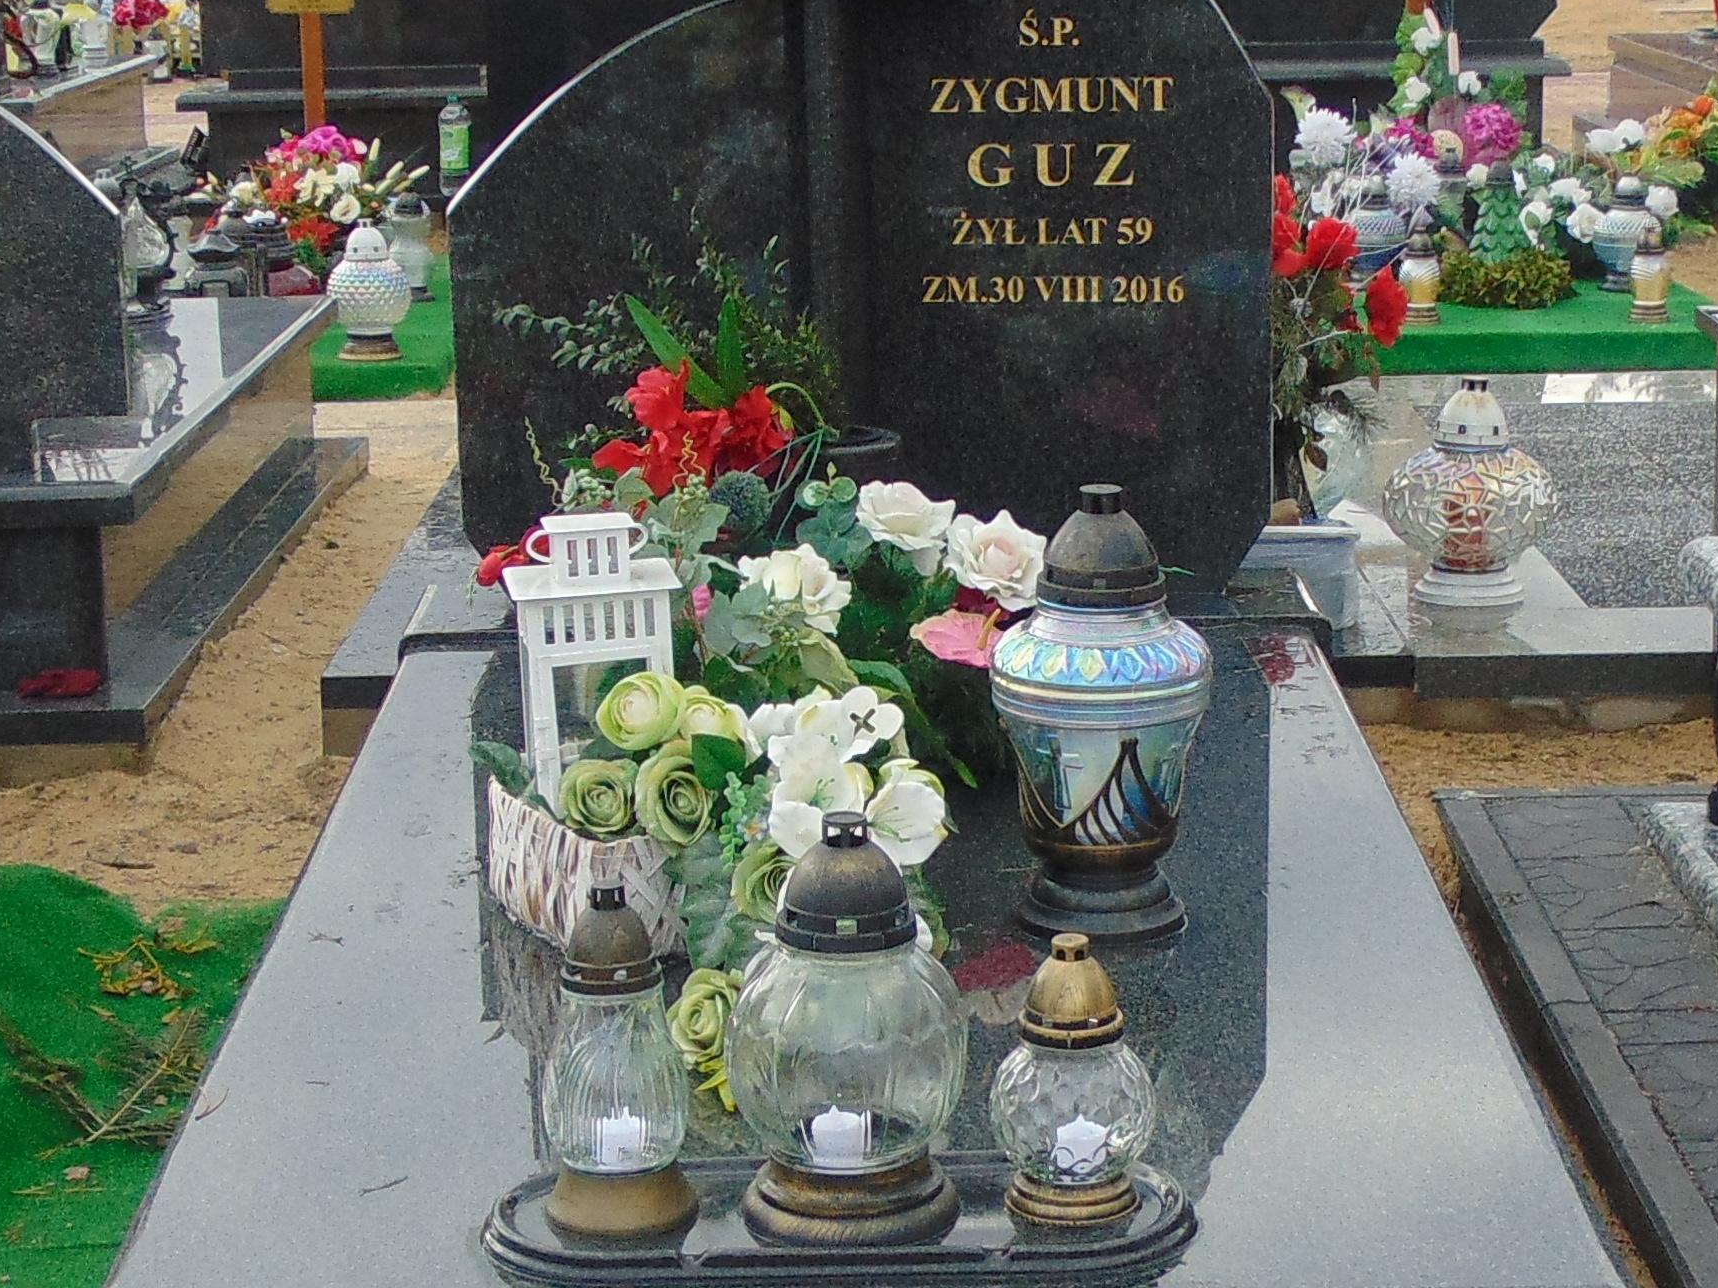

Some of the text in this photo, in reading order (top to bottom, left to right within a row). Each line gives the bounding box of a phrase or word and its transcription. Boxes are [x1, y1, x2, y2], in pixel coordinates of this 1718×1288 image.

[1019, 8, 1080, 47] Ś.P.
[929, 76, 1175, 113] ZYGMUNT
[951, 210, 1154, 245] ŻYŁ LAT 59
[921, 274, 1185, 304] ZM.30 VIII 2016
